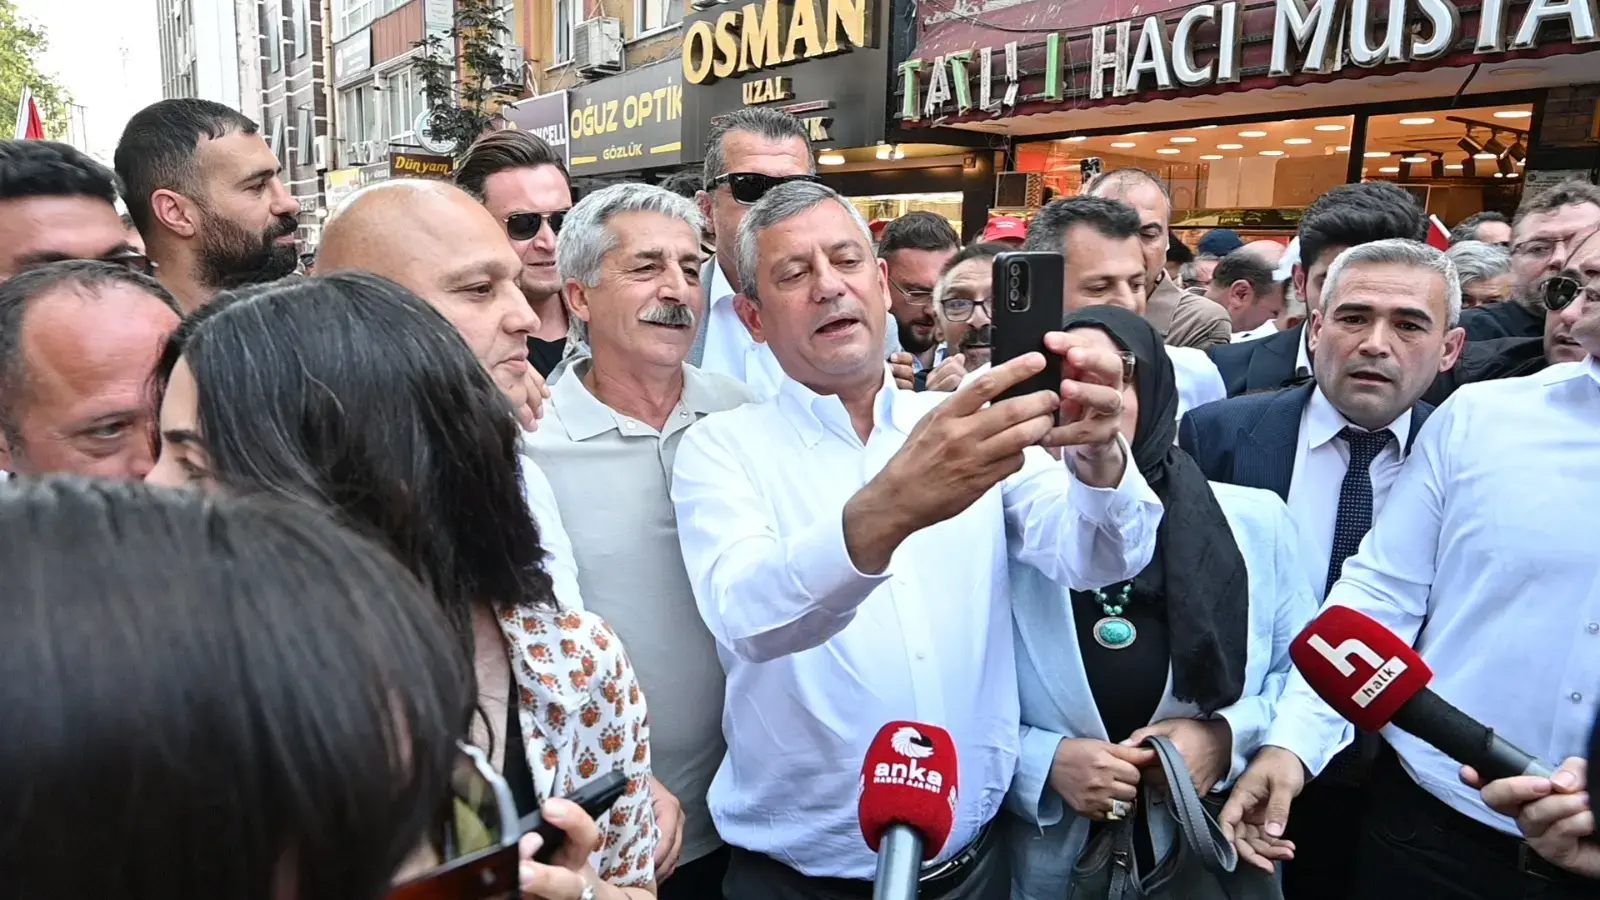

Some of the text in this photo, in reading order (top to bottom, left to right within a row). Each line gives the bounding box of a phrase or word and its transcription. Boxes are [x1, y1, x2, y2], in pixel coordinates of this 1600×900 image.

[682, 0, 866, 84] OSMAN
[1090, 1, 1236, 99] HACI
[743, 76, 786, 105] UZAL
[571, 78, 683, 139] OĞUZ OPTİK
[395, 156, 450, 175] Dünyam
[603, 142, 643, 160] GÖZLÜK
[1362, 667, 1396, 698] halk
[873, 776, 905, 785] HABER
[874, 759, 943, 787] anka
